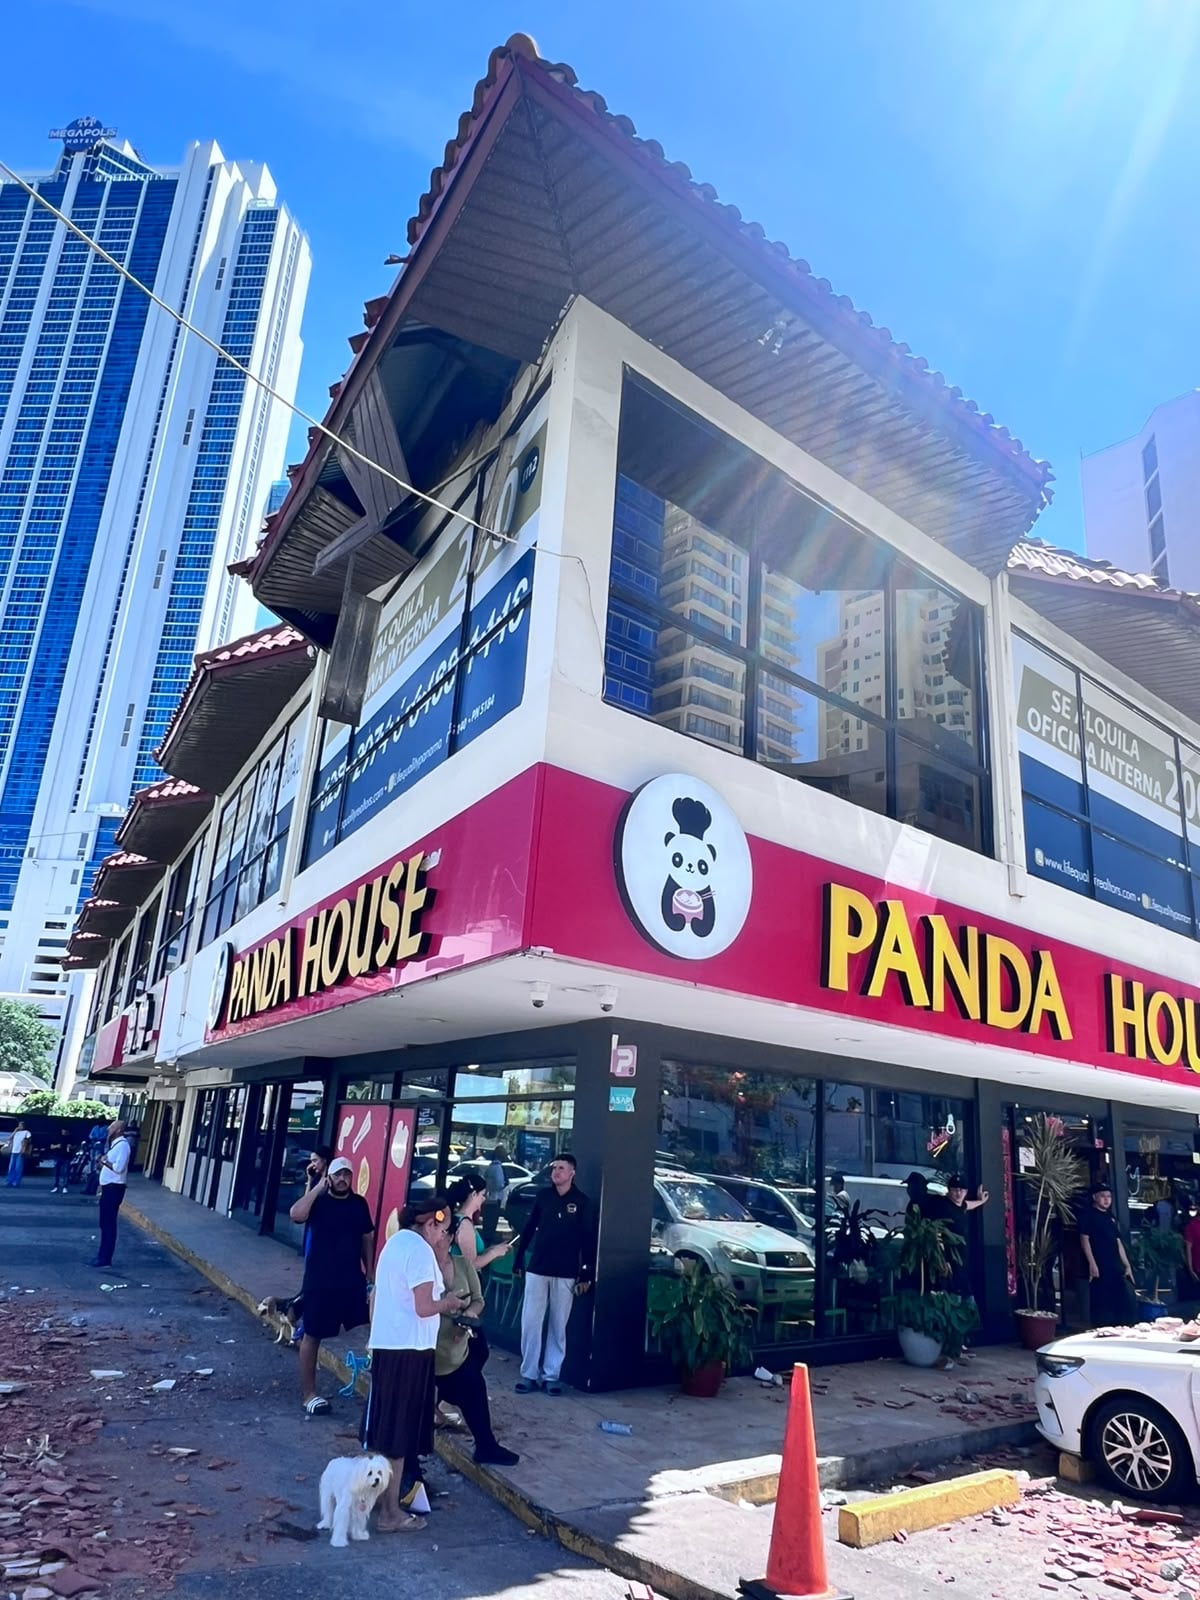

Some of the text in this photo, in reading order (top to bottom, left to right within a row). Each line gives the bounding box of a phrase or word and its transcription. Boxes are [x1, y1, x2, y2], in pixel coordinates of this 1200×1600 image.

[49, 127, 117, 138] MEGAPOLIS
[375, 584, 425, 663] ALQUILA
[383, 596, 440, 680] INTERNA
[1051, 689, 1071, 719] SE
[1100, 748, 1162, 803] INTERNA
[226, 851, 428, 1023] PANDA HOUSE
[823, 882, 1074, 1041] PANDA
